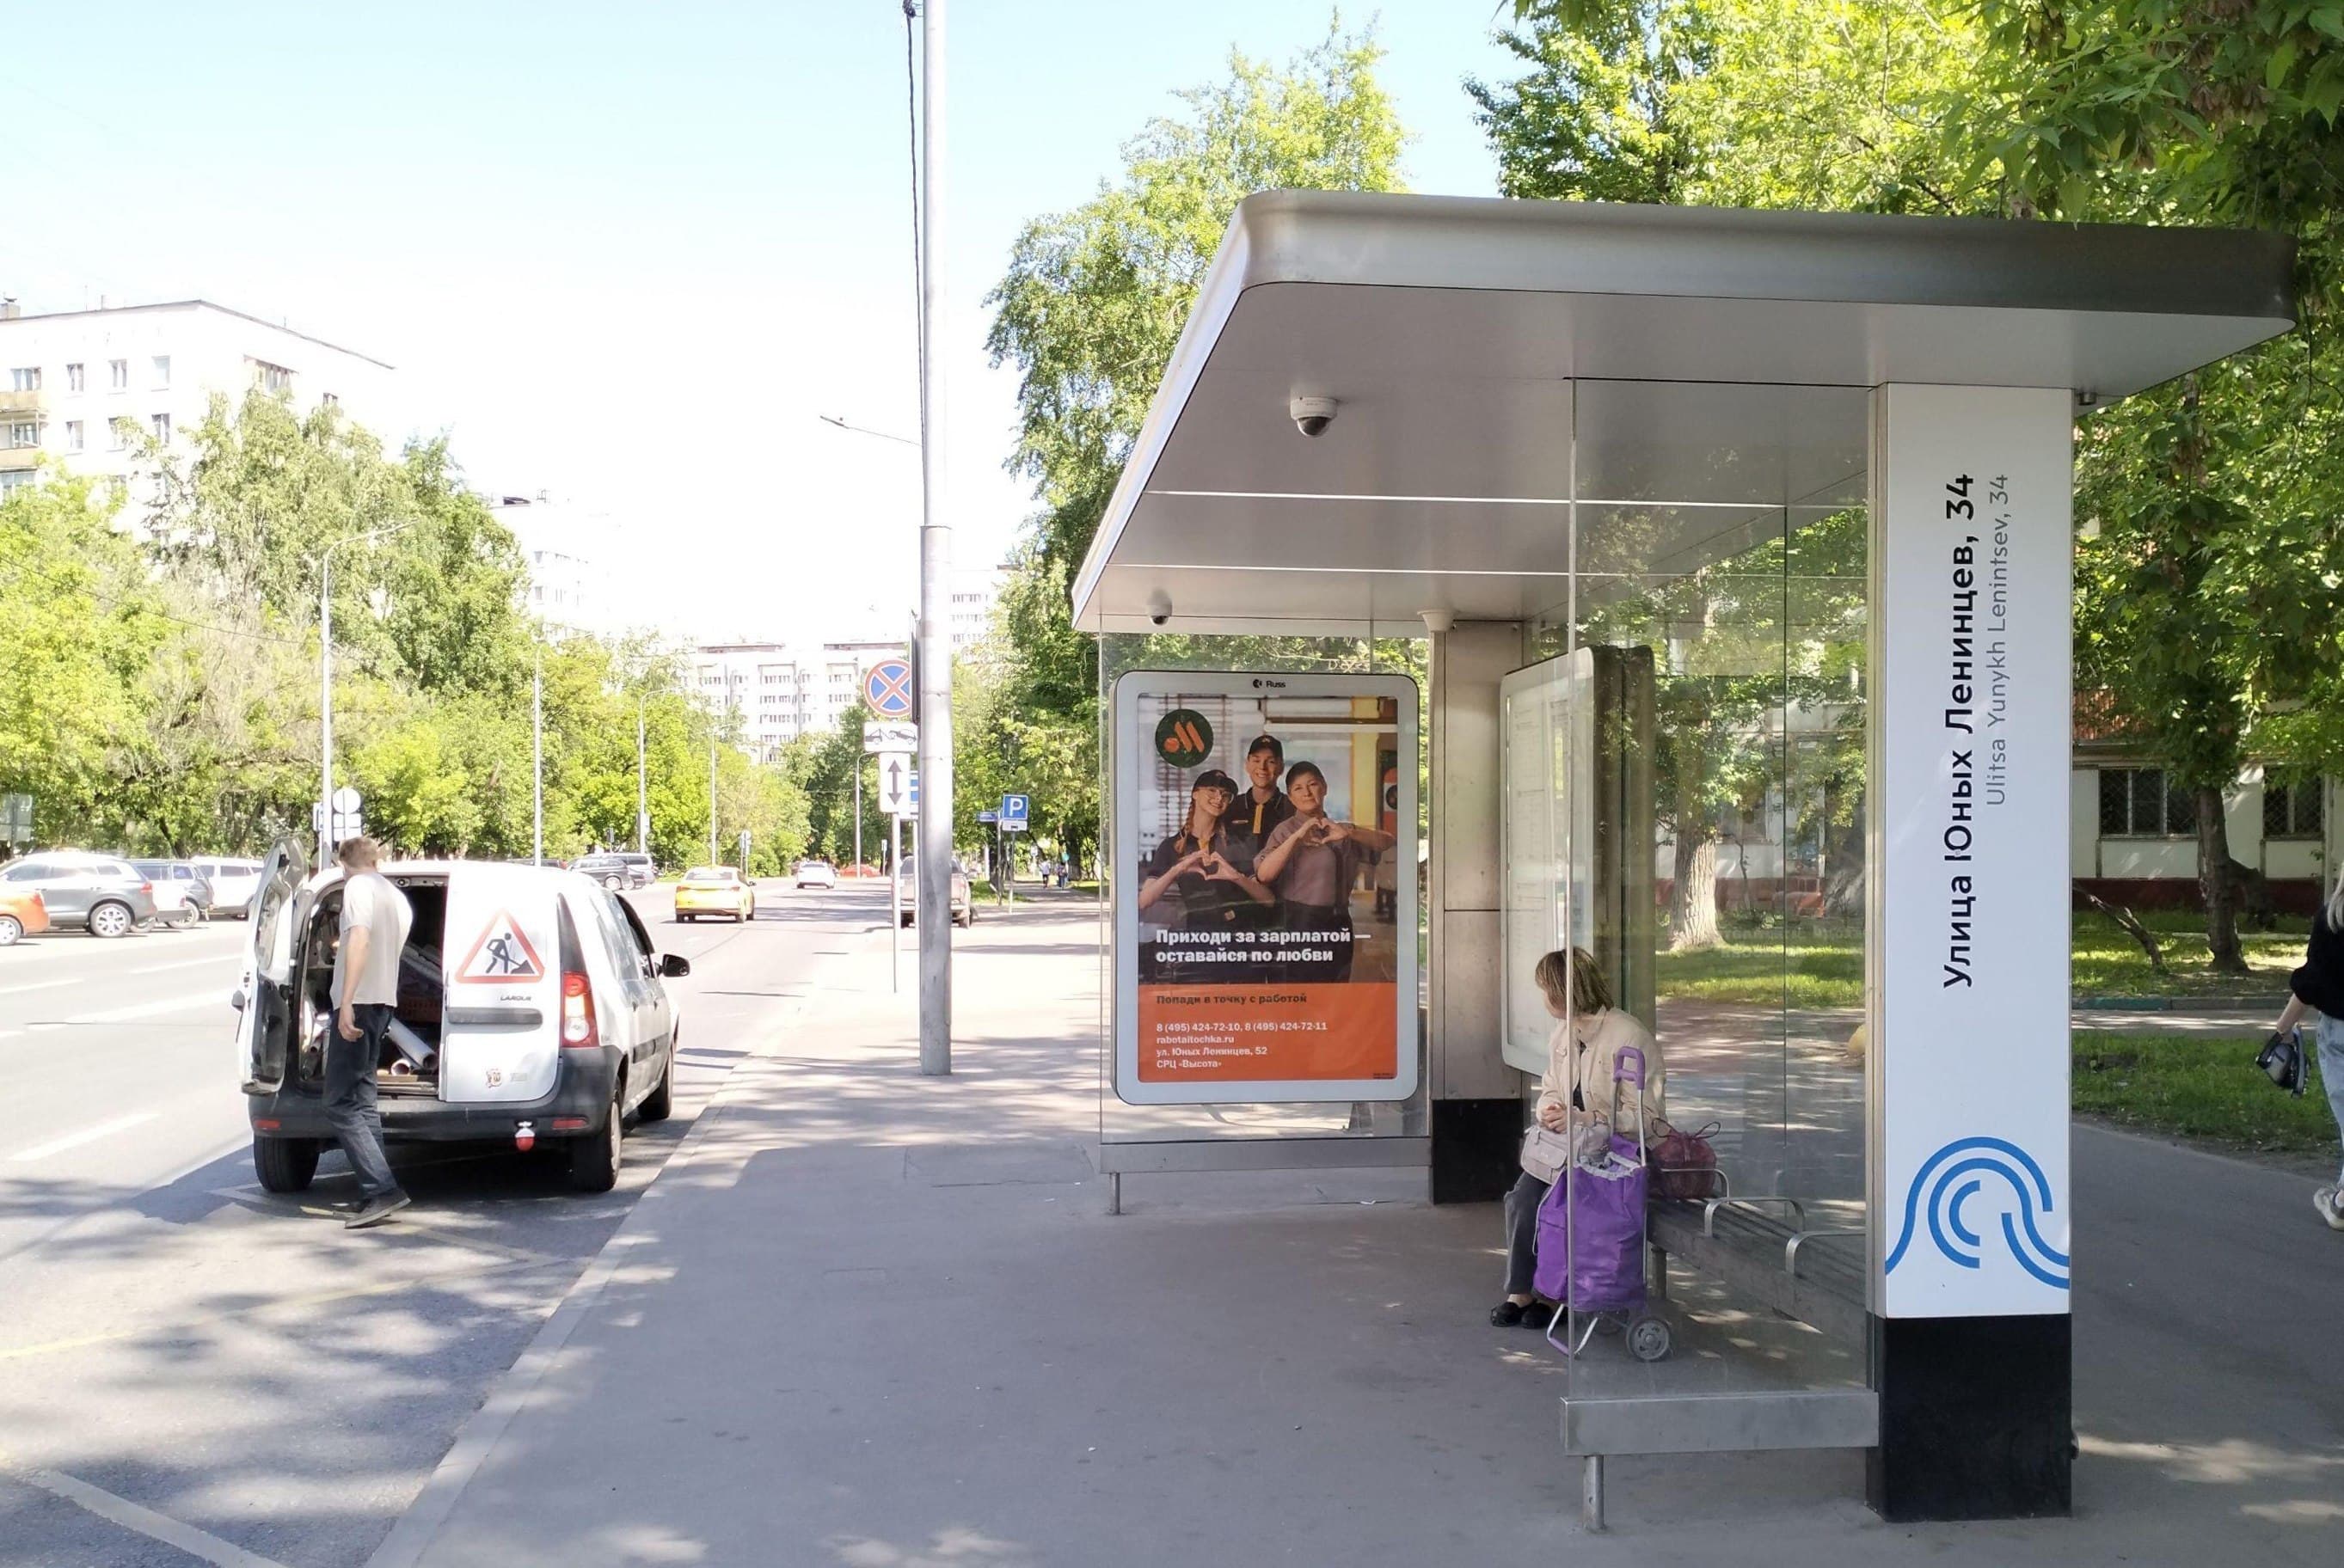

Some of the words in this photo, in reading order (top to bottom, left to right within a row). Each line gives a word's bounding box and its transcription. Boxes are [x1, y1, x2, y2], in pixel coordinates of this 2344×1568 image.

[1946, 474, 1974, 521] 34
[1989, 474, 2009, 505] 34
[1986, 512, 2012, 632] Lenintsev,
[1945, 536, 1979, 734] Ленинцев,
[1985, 641, 2011, 728] Yunykh
[1985, 738, 2007, 806] Ulitsa
[1009, 797, 1023, 817] P
[1943, 749, 1973, 861] Юных
[1156, 928, 1231, 945] Приходи
[1236, 932, 1255, 943] за
[1260, 928, 1351, 945] зарплатой
[1943, 875, 1977, 988] Улица
[1156, 947, 1247, 963] оставайся
[1251, 951, 1273, 962] по
[1276, 948, 1334, 962] любви
[1157, 995, 1201, 1005] Попади
[1212, 995, 1247, 1005] точку
[1258, 992, 1307, 1005] работой
[1157, 1023, 1163, 1032] 8
[1164, 1023, 1190, 1033] (495)
[1192, 1022, 1243, 1032] 424-72-10,
[1244, 1022, 1251, 1032] 8
[1253, 1022, 1279, 1032] (495)
[1279, 1021, 1328, 1032] 424-72-11
[1157, 1035, 1235, 1044] rabotaitochka.ru
[1157, 1048, 1170, 1058] ул.
[1172, 1047, 1200, 1057] Юных
[1203, 1046, 1253, 1057] Ленинцев,
[1255, 1046, 1267, 1056] 52
[1157, 1059, 1176, 1069] СРЦ
